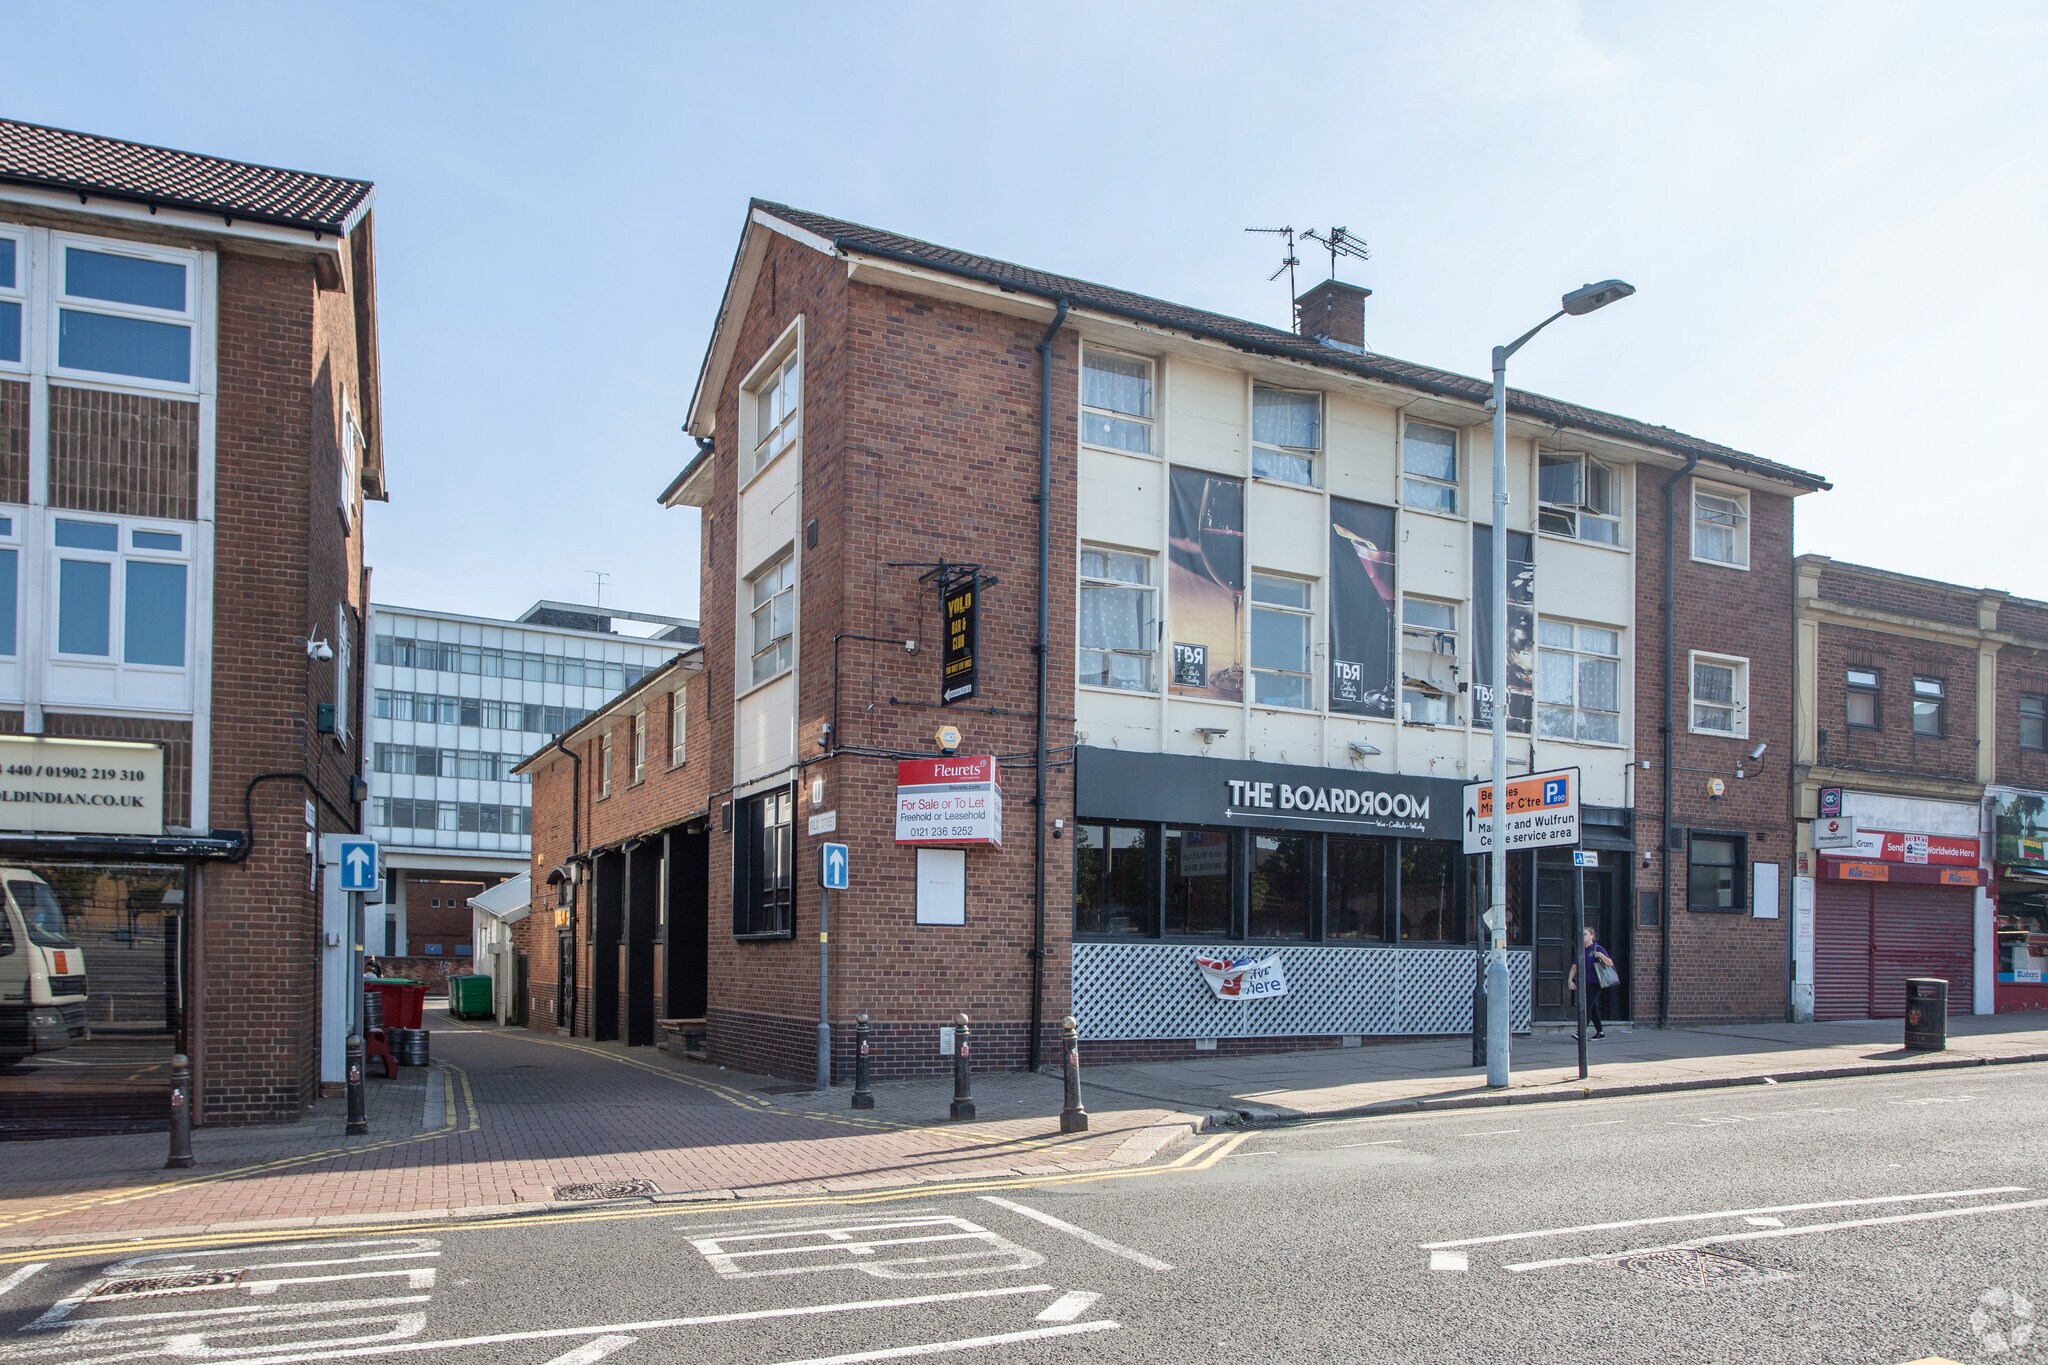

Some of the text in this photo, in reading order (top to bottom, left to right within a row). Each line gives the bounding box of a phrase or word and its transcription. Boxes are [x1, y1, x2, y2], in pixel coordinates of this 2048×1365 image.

[948, 592, 972, 618] YOLO
[951, 618, 961, 635] BAR
[952, 634, 965, 651] CLUB
[6, 764, 32, 777] 440
[45, 766, 87, 779] 01902
[92, 768, 116, 780] 219
[119, 769, 145, 781] 310
[934, 764, 981, 777] Fleurets
[0, 790, 145, 808] LDINDIAN.CO.UK
[1228, 780, 1274, 808] THE
[1481, 788, 1519, 801] Beies
[1546, 783, 1559, 804] P
[1554, 795, 1566, 803] 890
[901, 797, 985, 811] For Sale or To Let
[1481, 801, 1515, 814] Maer
[900, 812, 932, 822] Freehold
[944, 810, 986, 821] Leasehold
[1514, 818, 1531, 830] and
[1534, 814, 1575, 827] Wulfrun
[910, 826, 973, 837] 0121 236 5252
[1513, 831, 1547, 843] service
[1550, 828, 1572, 839] area
[1887, 842, 1904, 852] Send
[1959, 849, 1975, 858] Here
[1848, 865, 1863, 877] Ria
[1948, 872, 1962, 883] Ria
